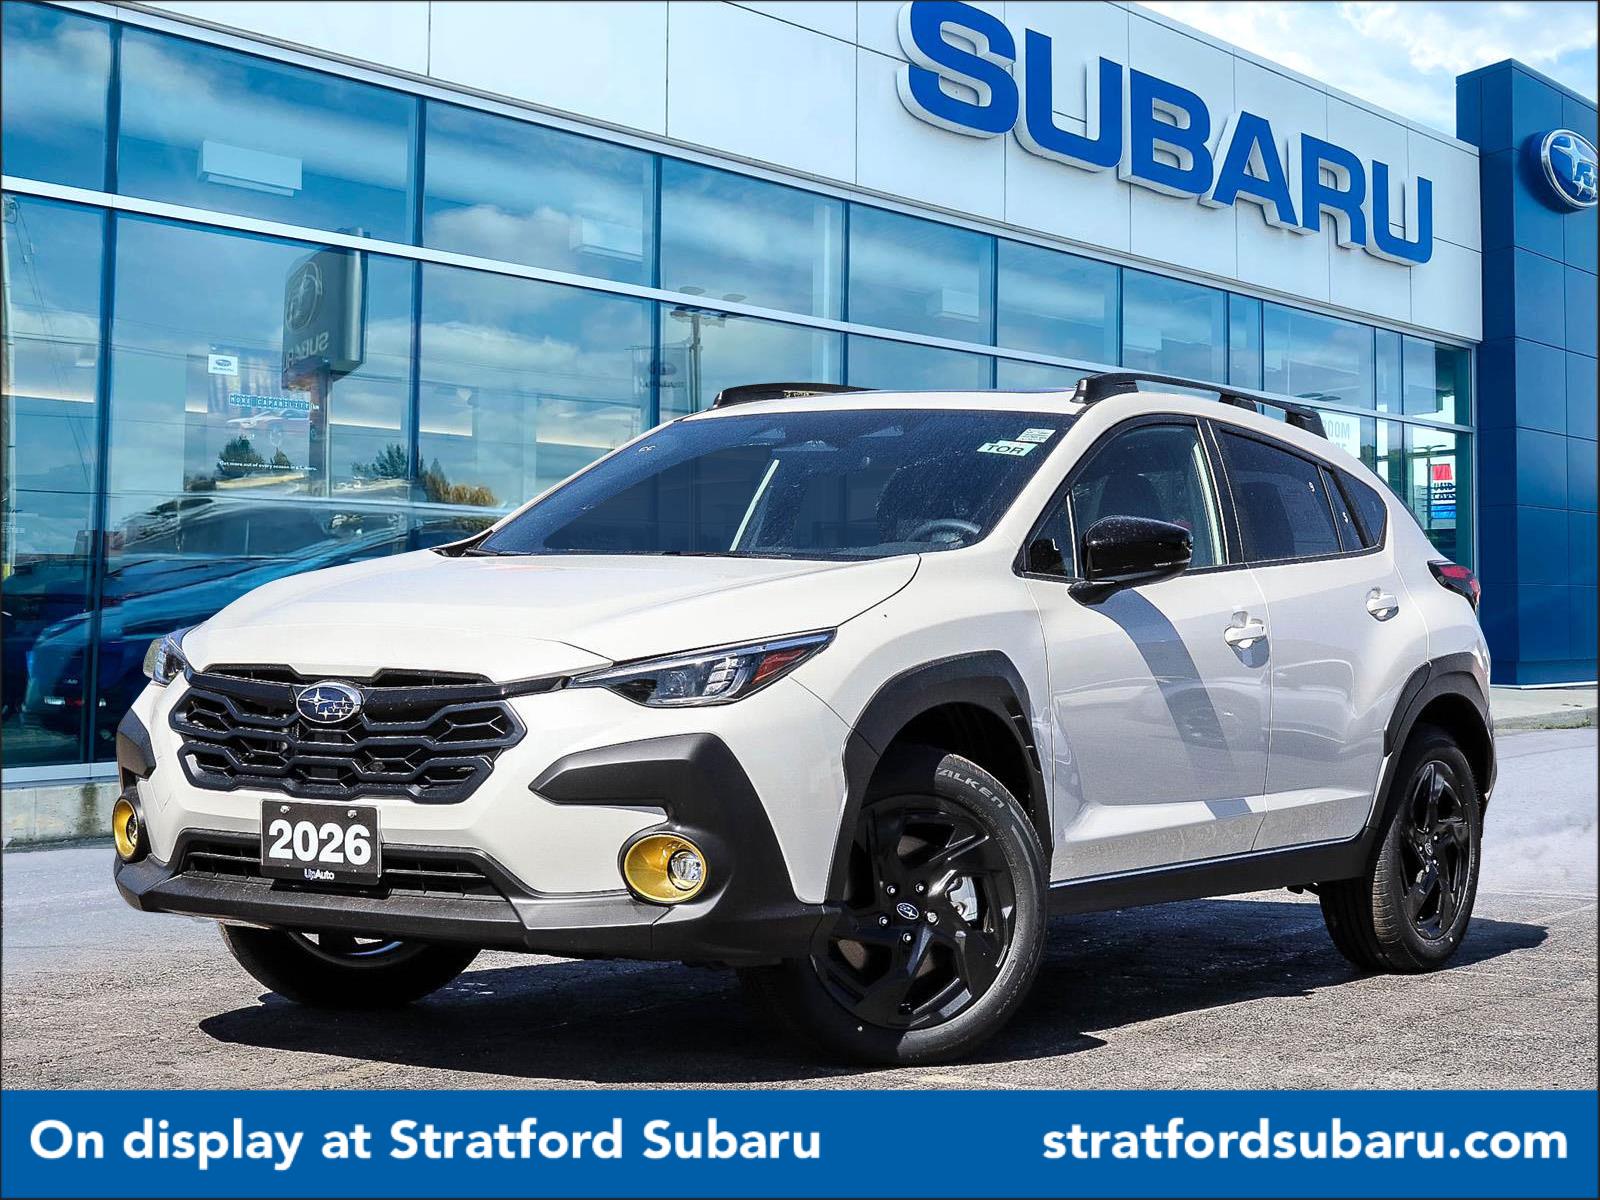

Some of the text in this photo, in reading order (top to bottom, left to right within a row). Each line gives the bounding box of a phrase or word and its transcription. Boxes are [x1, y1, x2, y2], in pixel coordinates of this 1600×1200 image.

[908, 1, 1433, 264] SUBARU
[987, 444, 1024, 454] TOR
[268, 819, 372, 866] 2026
[304, 868, 335, 881] UpAuto
